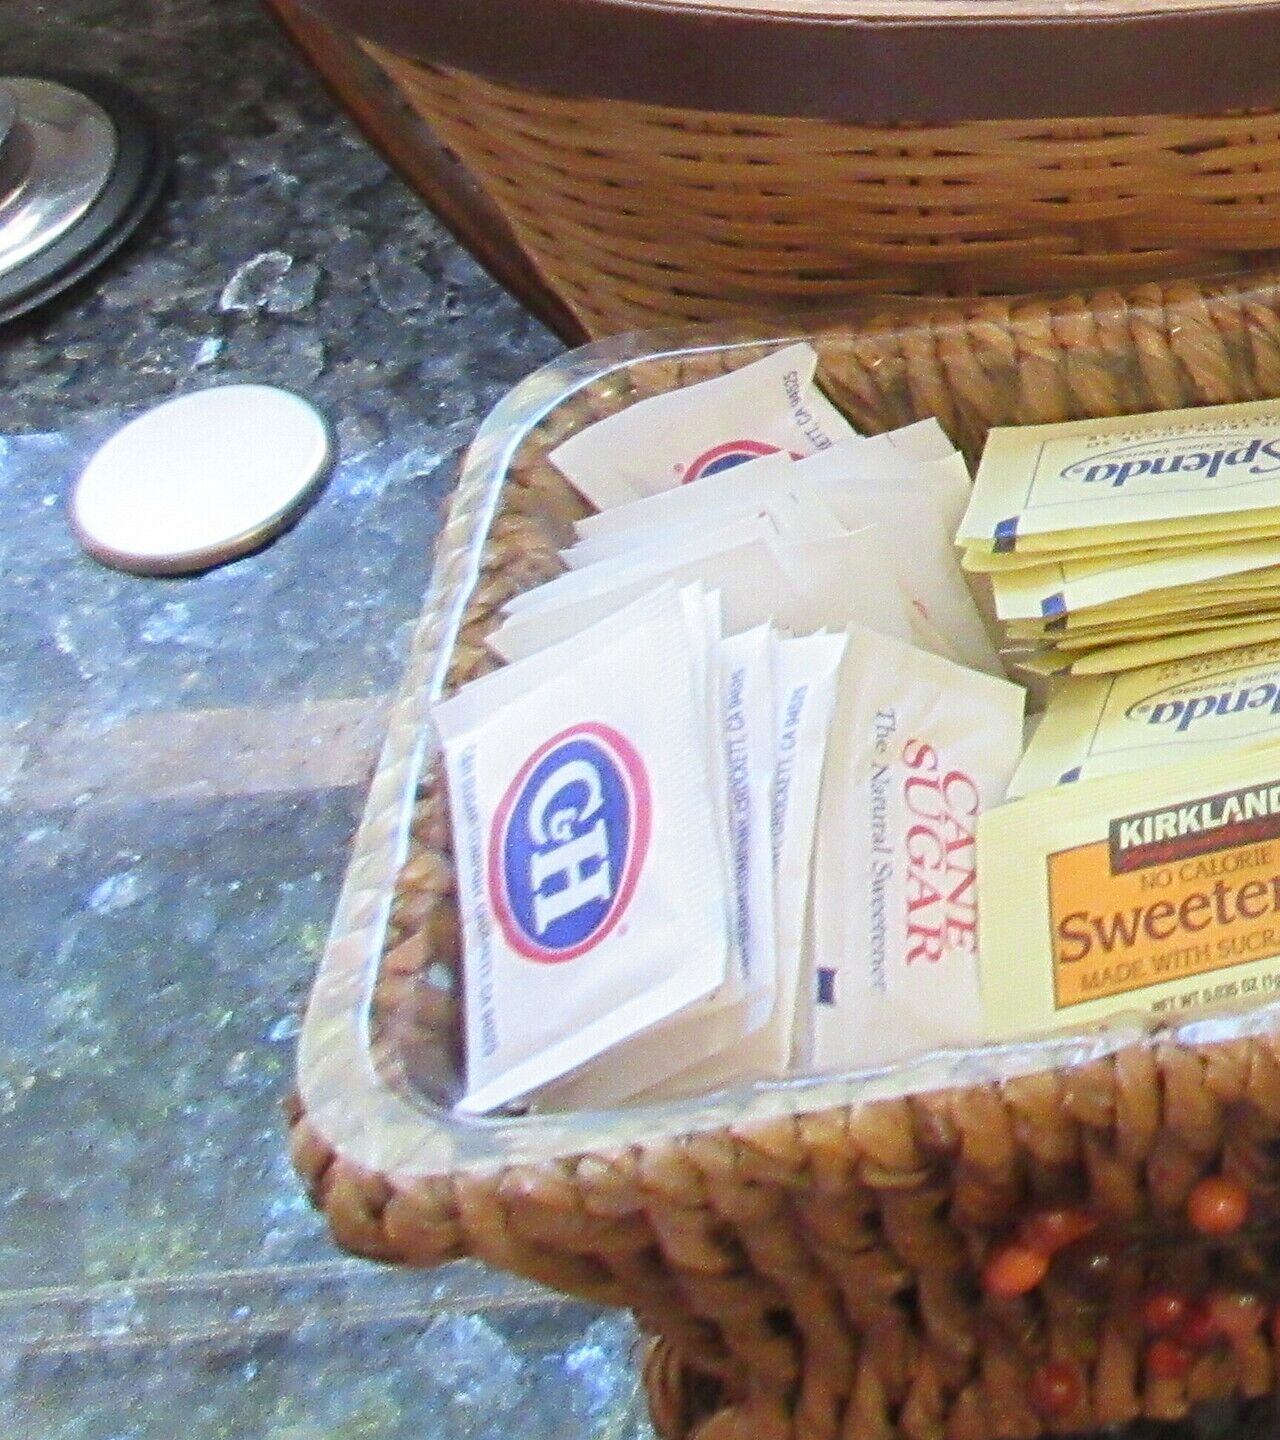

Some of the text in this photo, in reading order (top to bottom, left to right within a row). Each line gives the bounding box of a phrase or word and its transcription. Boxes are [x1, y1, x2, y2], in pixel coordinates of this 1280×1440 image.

[874, 707, 897, 755] The
[870, 763, 895, 856] Natural
[902, 738, 944, 967] SUGAR
[941, 769, 981, 954] CANE
[1140, 844, 1275, 892] NO CALORIE
[1080, 959, 1147, 992] MADE
[1150, 943, 1213, 976] WITH
